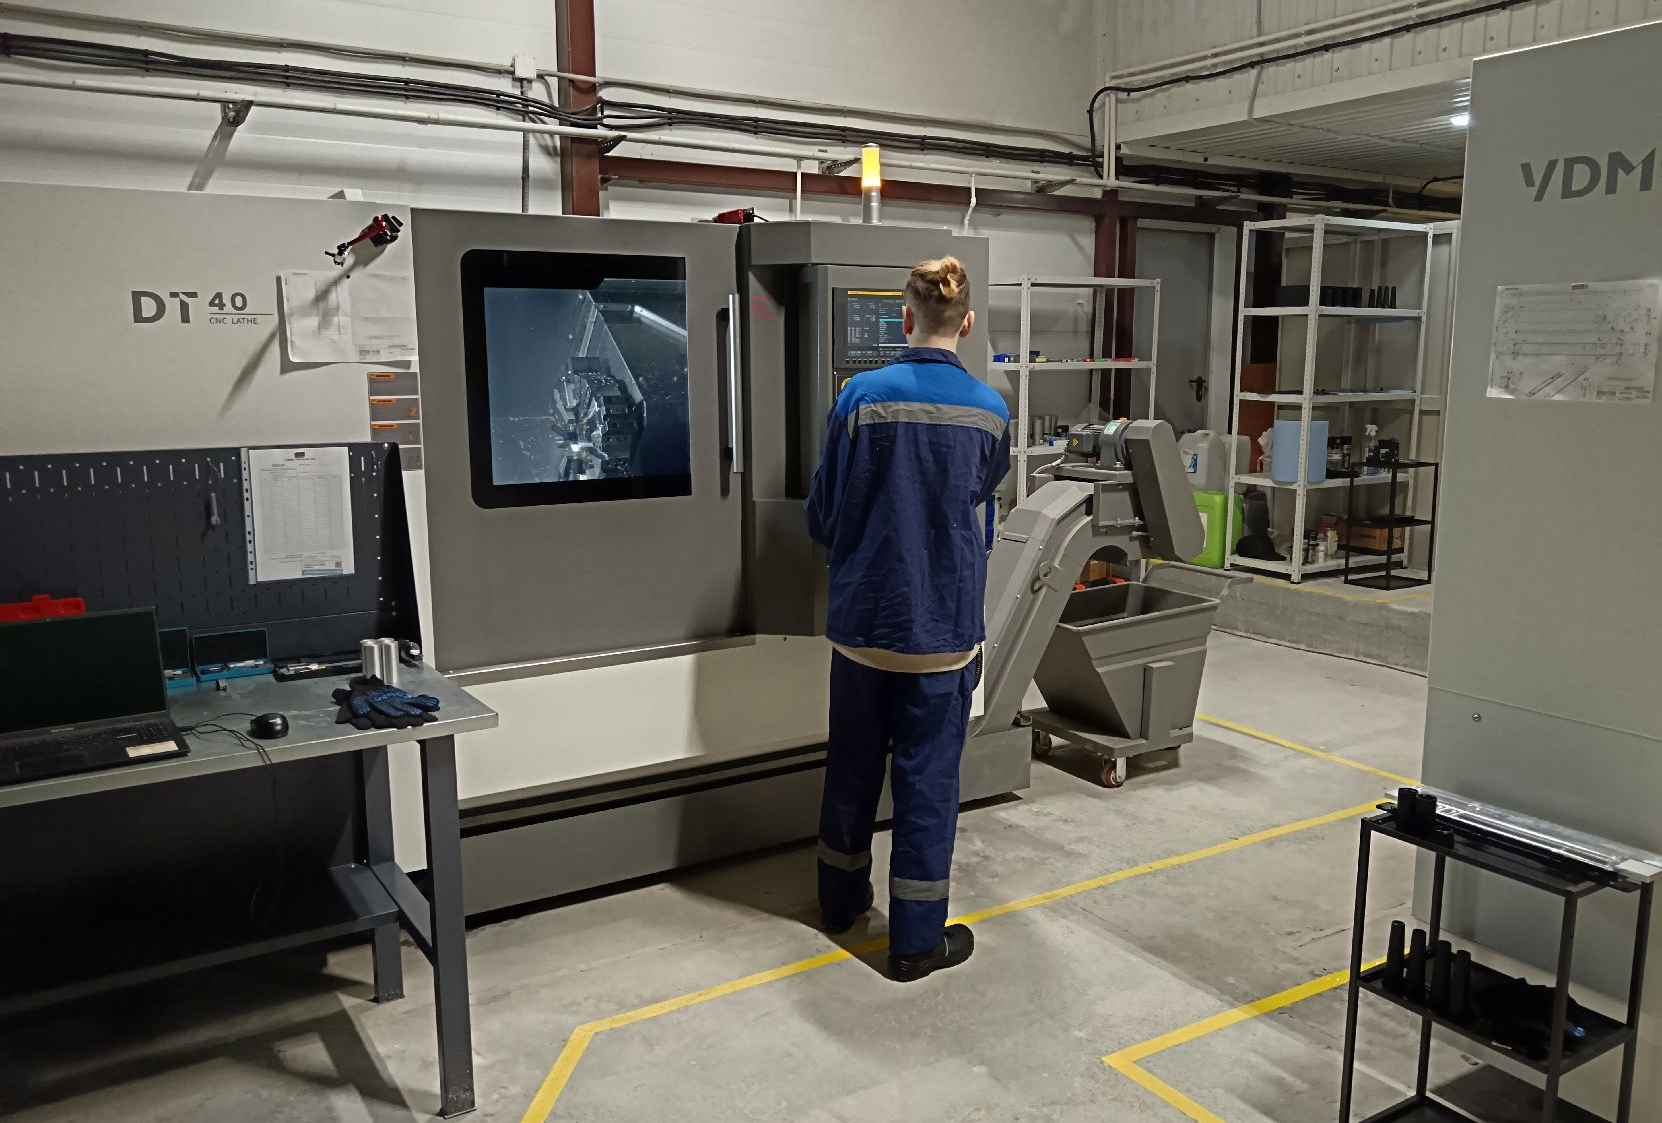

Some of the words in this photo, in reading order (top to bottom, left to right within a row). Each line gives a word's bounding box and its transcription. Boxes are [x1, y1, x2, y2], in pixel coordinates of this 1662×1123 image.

[1520, 147, 1657, 202] VDM
[131, 290, 199, 324] DT
[208, 291, 248, 312] 40
[209, 316, 228, 325] CNC
[231, 317, 259, 325] LATHE
